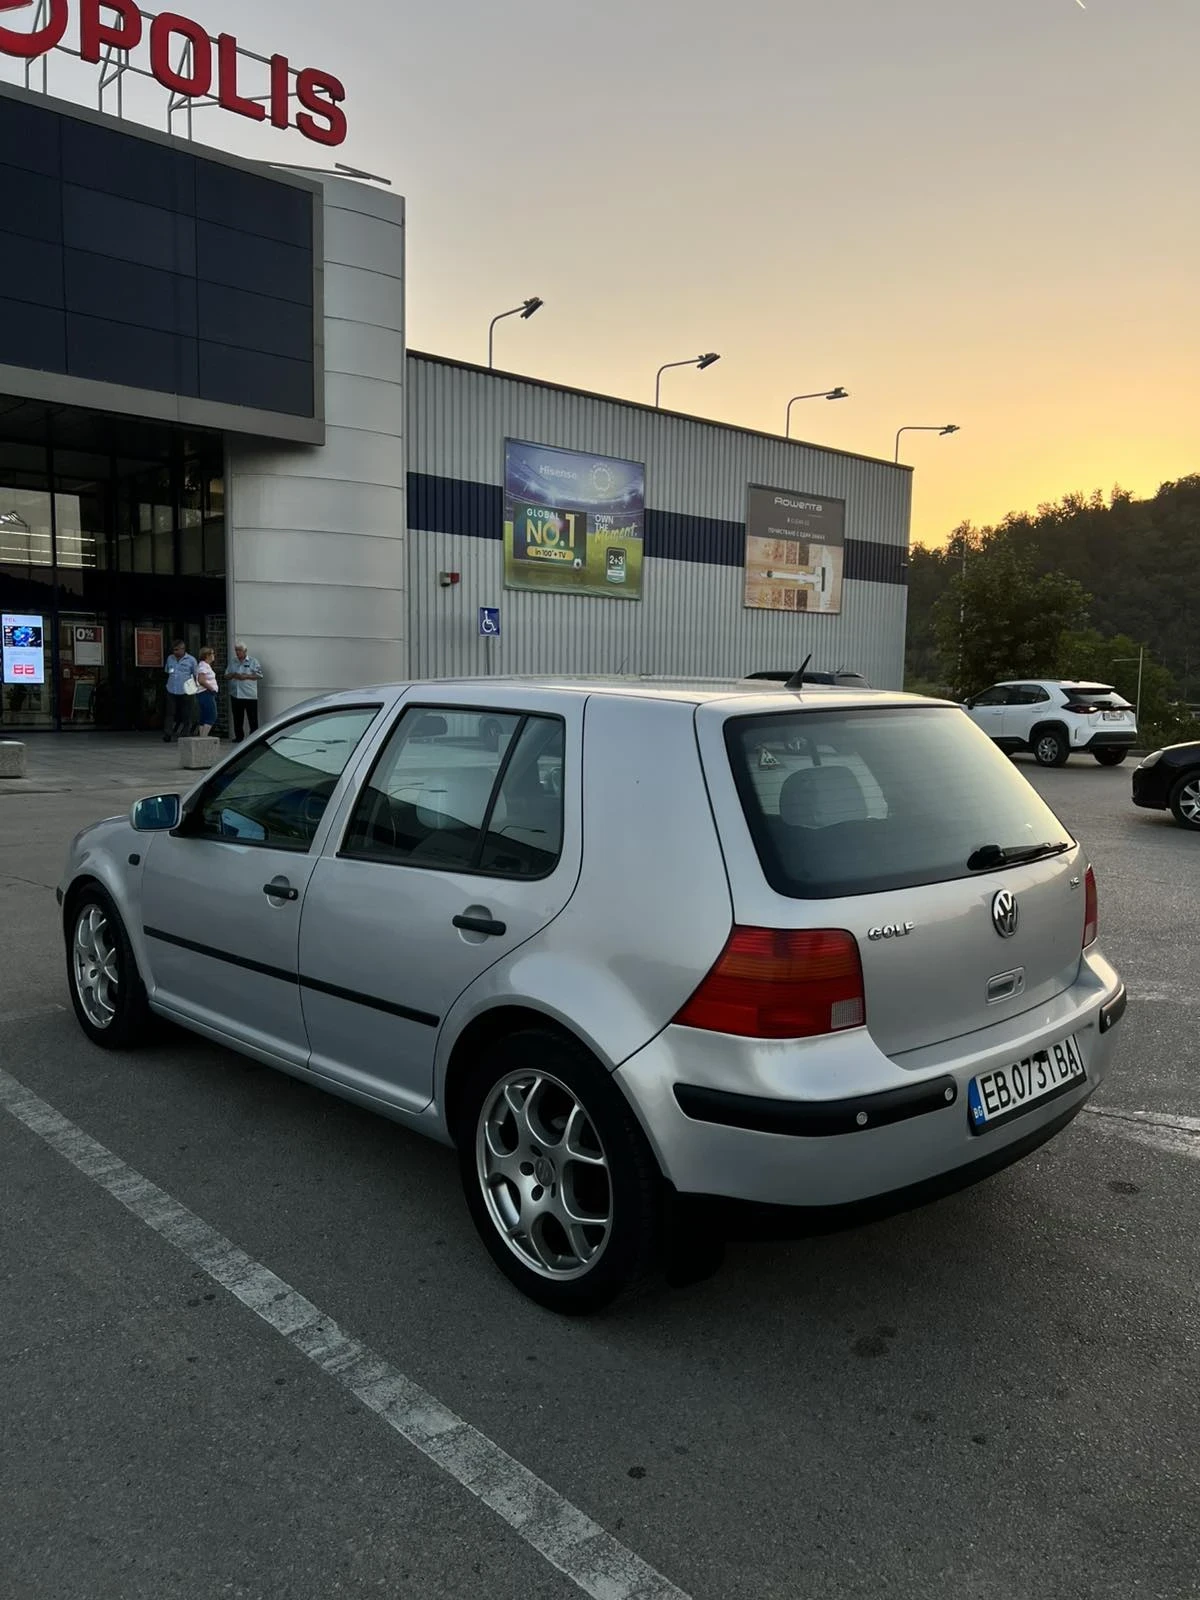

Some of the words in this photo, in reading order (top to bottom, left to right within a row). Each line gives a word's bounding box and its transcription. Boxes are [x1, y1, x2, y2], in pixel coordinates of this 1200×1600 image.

[539, 464, 577, 480] Hisense
[774, 496, 823, 512] Rowenta
[526, 507, 560, 521] GLOBAL
[594, 514, 614, 525] OWN
[594, 522, 609, 532] THE
[867, 921, 915, 941] GOLF
